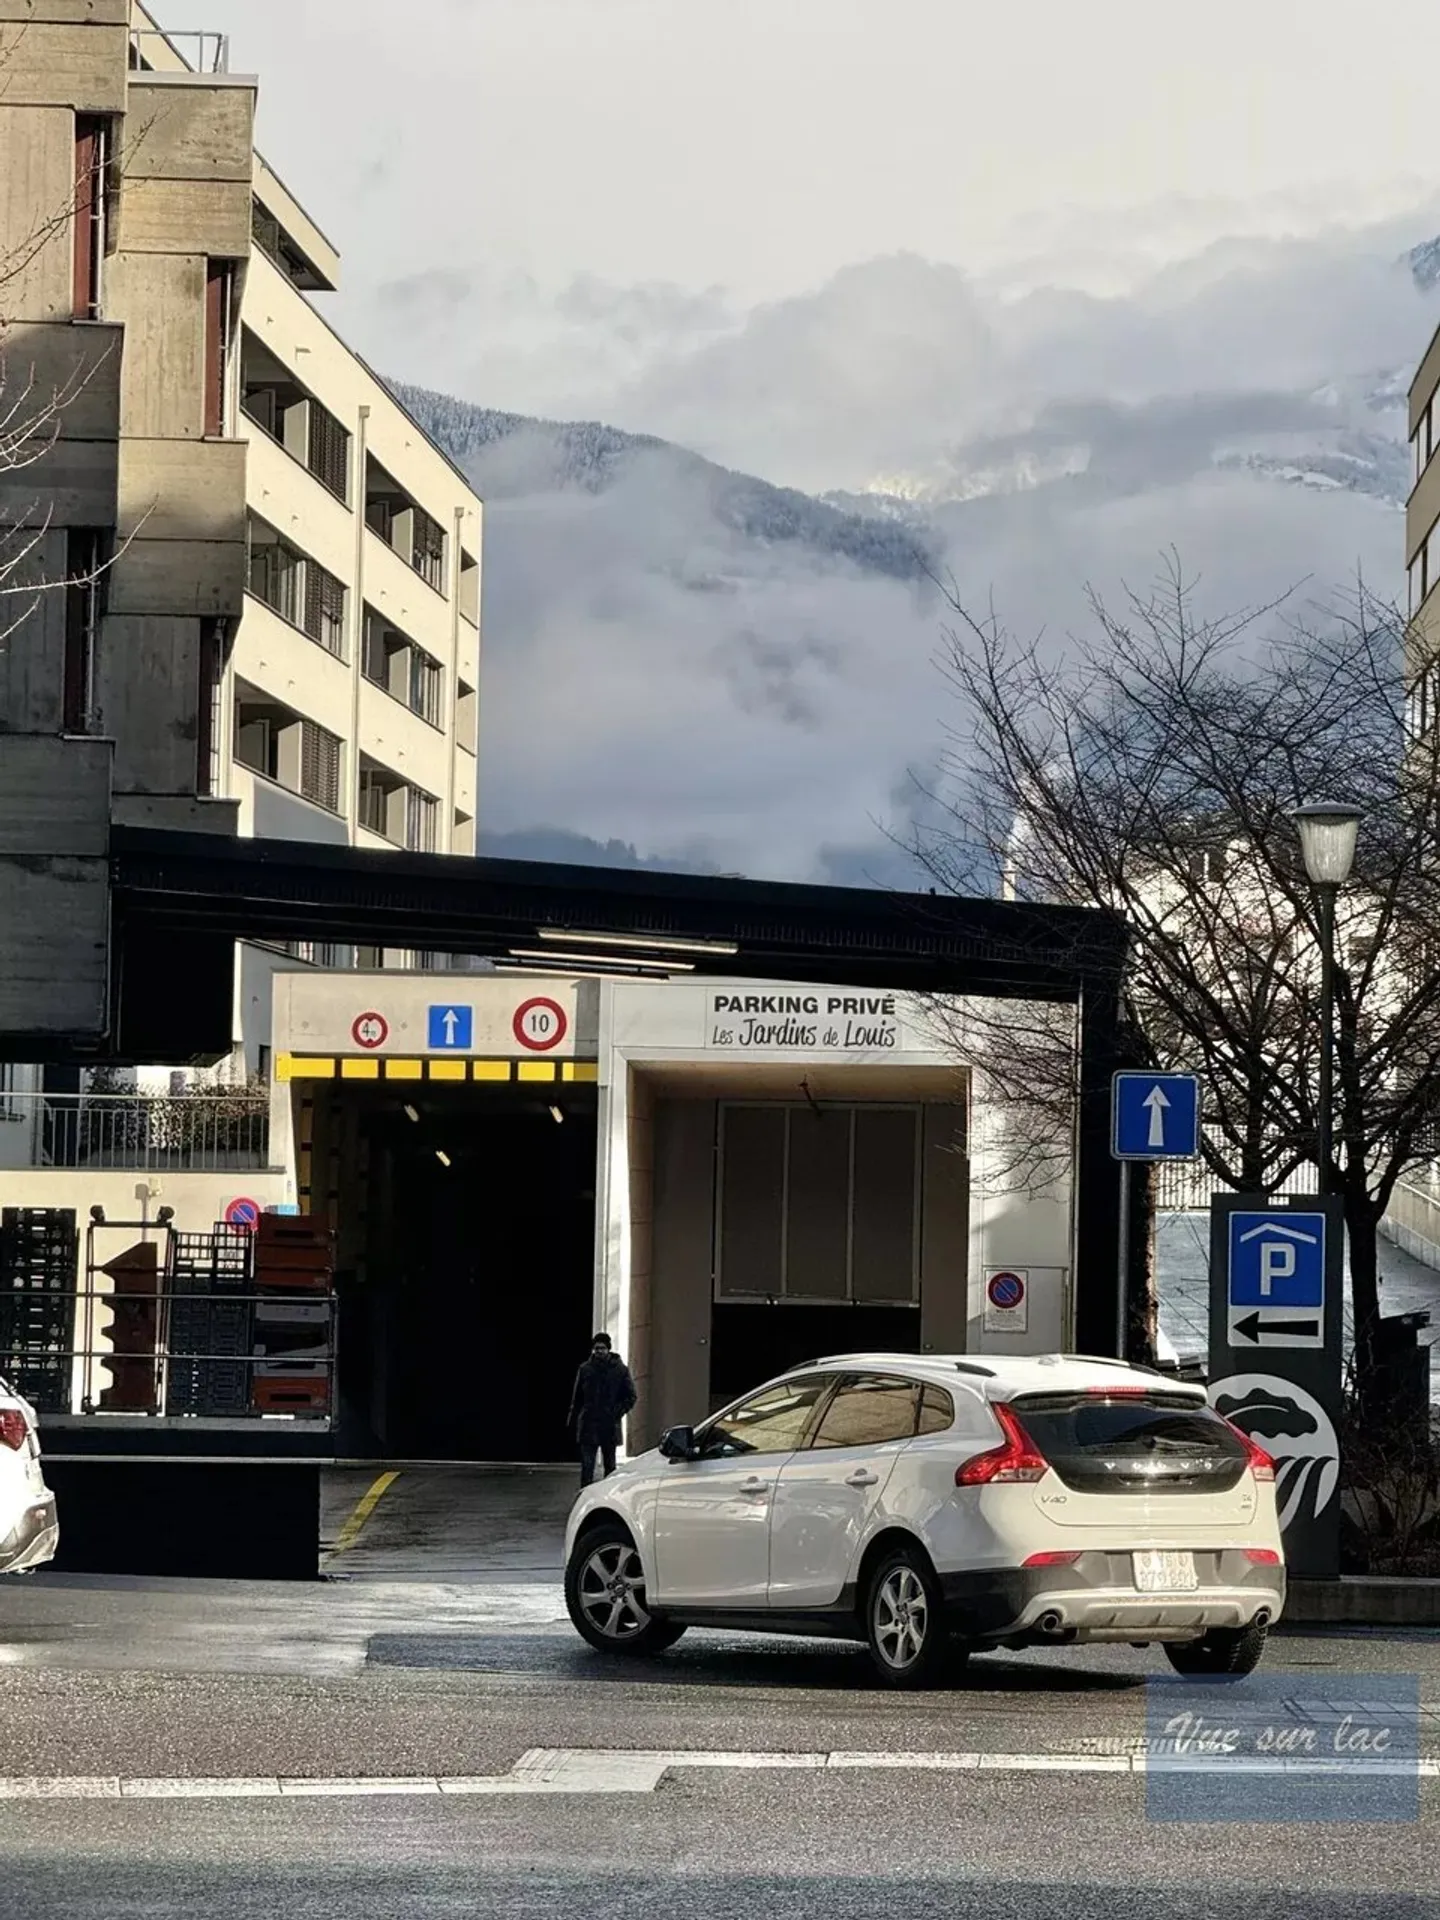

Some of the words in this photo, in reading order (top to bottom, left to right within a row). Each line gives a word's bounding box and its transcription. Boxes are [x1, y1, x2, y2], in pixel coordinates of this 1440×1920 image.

[714, 996, 818, 1014] PARKING
[827, 993, 896, 1015] PRIVÉ
[530, 1013, 550, 1033] 10
[712, 1025, 734, 1045] Les
[739, 1018, 817, 1047] Jardins
[823, 1026, 839, 1047] de
[844, 1020, 897, 1048] Louis
[1260, 1242, 1296, 1296] P
[1041, 1495, 1068, 1504] V40
